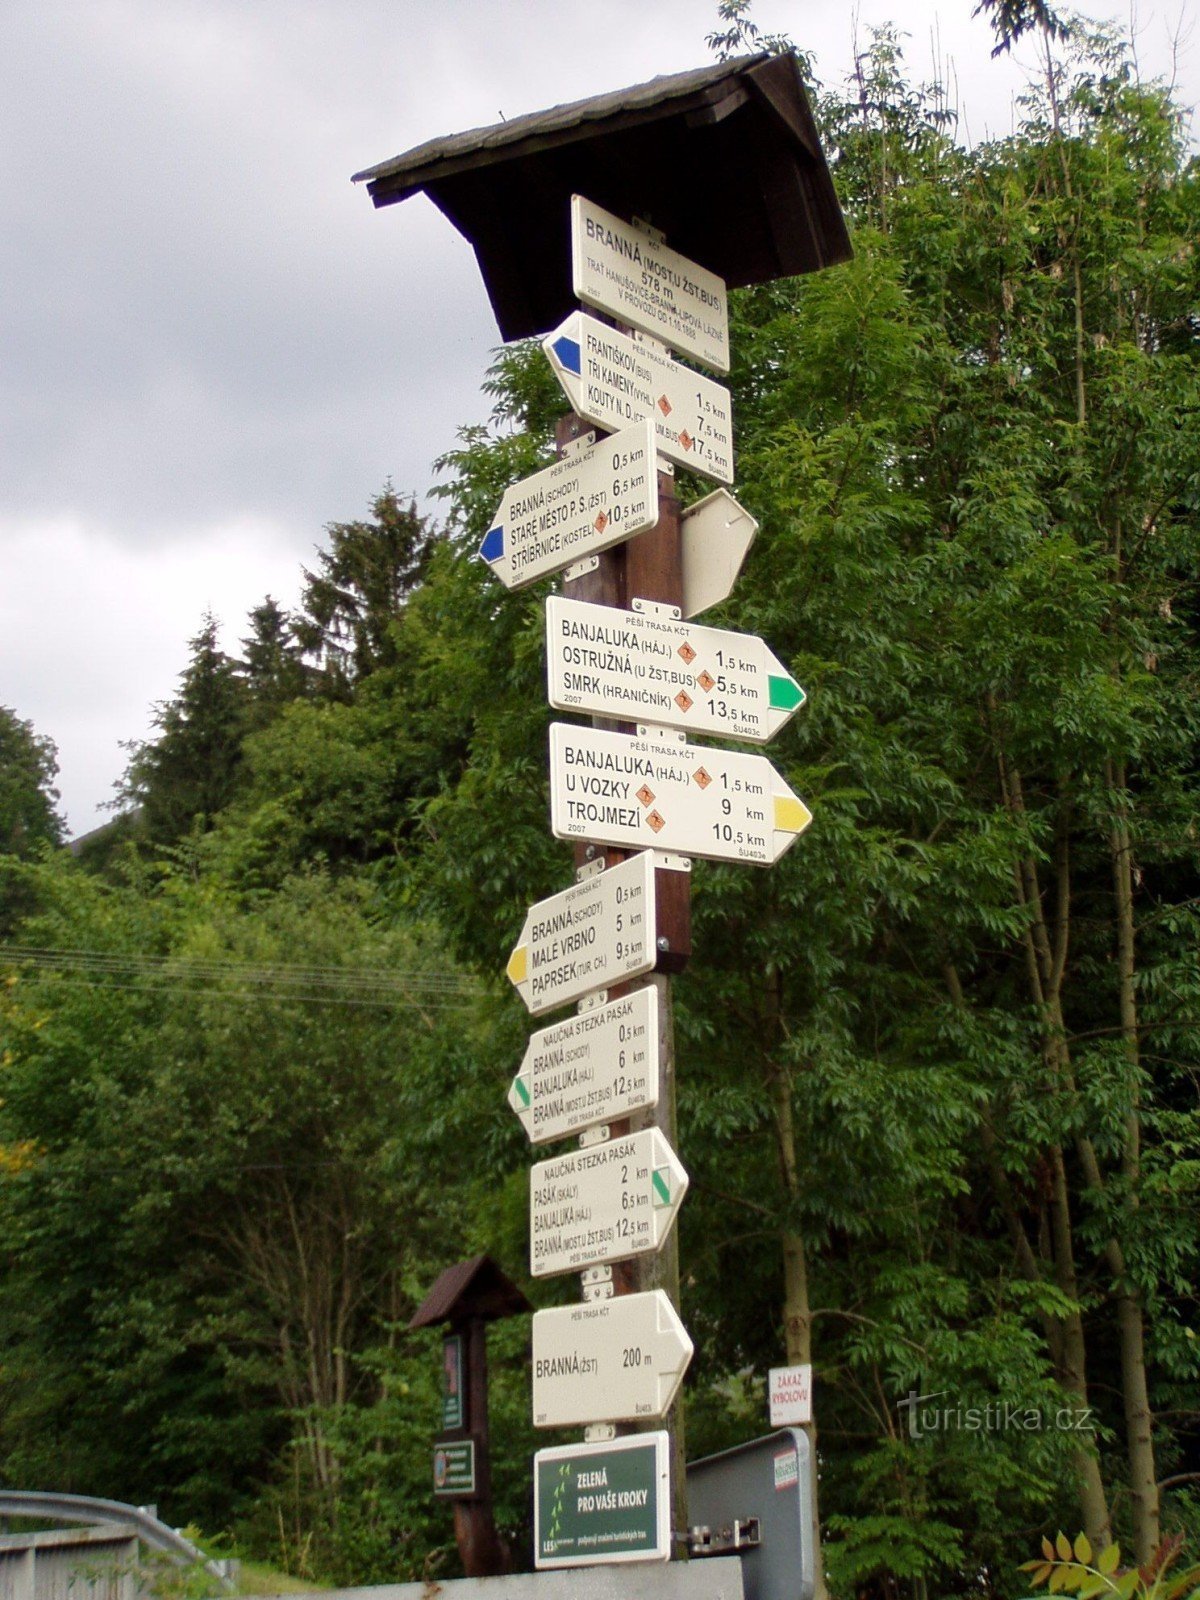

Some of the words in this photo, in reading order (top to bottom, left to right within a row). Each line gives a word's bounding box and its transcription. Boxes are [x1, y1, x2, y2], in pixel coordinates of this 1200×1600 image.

[587, 218, 642, 266] BRANNÁ
[619, 288, 623, 298] V
[625, 292, 656, 317] PROVOZU
[658, 310, 667, 322] OD
[642, 271, 659, 292] 578
[664, 287, 673, 300] m
[587, 334, 635, 372] FRANTIŠKOV
[637, 366, 651, 384] (BUS)
[697, 393, 710, 412] 1,5
[713, 405, 725, 420] km
[588, 358, 600, 380] TŘI
[602, 367, 634, 396] KAMENY
[697, 416, 711, 436] 7,5
[714, 429, 726, 443] km
[589, 406, 602, 416] 2007
[588, 384, 614, 411] KOUTY
[616, 398, 624, 416] N.
[626, 403, 633, 420] D.
[692, 437, 712, 460] 17,5
[715, 452, 727, 467] km
[564, 457, 582, 471] TRASA
[583, 451, 595, 463] KČT
[510, 487, 544, 521] BRANNÁ
[546, 479, 580, 506] (SCHODY)
[613, 454, 628, 471] 0,5
[630, 449, 644, 462] km
[510, 519, 537, 546] STARÉ
[540, 505, 568, 532] MĚSTO
[570, 501, 577, 517] P.
[579, 497, 587, 513] S.
[588, 491, 606, 512] (ŽST)
[613, 480, 628, 497] 6,5
[630, 475, 644, 489] km
[512, 533, 560, 570] STŘÍBRNICE
[561, 523, 595, 550] (KOSTEL)
[607, 506, 628, 525] 10,5
[630, 501, 645, 515] km
[512, 572, 523, 583] 2007
[562, 620, 639, 650] BANJALUKA
[642, 641, 672, 659] (HÁJ.)
[716, 651, 735, 670] 1,5
[739, 660, 756, 673] km
[626, 617, 643, 627] PĚŠÍ
[647, 621, 672, 633] TRASA
[674, 628, 689, 636] KČT
[563, 646, 632, 674] OSTRUŽNÁ
[635, 665, 645, 679] (U
[649, 665, 696, 689] ŽST,BUS)
[717, 676, 736, 695] 5,5
[741, 685, 758, 698] km
[564, 672, 600, 694] SMRK
[603, 685, 671, 710] (HRANIČNÍK)
[708, 699, 737, 720] 13,5
[741, 711, 759, 724] km
[564, 695, 582, 704] 2007
[565, 747, 654, 777] BANJALUKA
[656, 767, 689, 785] (HÁJ.)
[721, 773, 741, 792] 1,5
[745, 782, 763, 794] km
[631, 742, 648, 752] PĚŠÍ
[651, 746, 676, 756] TRASA
[680, 749, 695, 759] KČT
[566, 774, 575, 791] U
[581, 776, 629, 799] VOZKY
[722, 798, 731, 815] 9
[746, 807, 764, 820] km
[567, 801, 640, 828] TROJMEZÍ
[713, 823, 743, 844] 10,5
[747, 834, 765, 846] km
[568, 824, 586, 833] 2007
[532, 906, 572, 943] BRANNÁ
[573, 901, 603, 928] (SCHODY)
[616, 887, 628, 904] 0,5
[630, 886, 641, 897] km
[532, 939, 558, 969] MALÉ
[561, 926, 596, 954] VRBNO
[616, 914, 622, 932] 5
[630, 913, 642, 926] km
[532, 961, 577, 996] PAPRSEK
[616, 942, 629, 960] 9,5
[631, 941, 643, 954] km
[543, 1026, 574, 1048] NAUČNÁ
[576, 1014, 605, 1035] STEZKA
[607, 1001, 633, 1021] PASÁK
[534, 1043, 565, 1075] BRANNÁ
[619, 1025, 631, 1043] 0,5
[633, 1024, 645, 1038] km
[534, 1068, 577, 1100] BANJALUKA
[619, 1051, 625, 1069] 6
[633, 1051, 645, 1064] km
[534, 1096, 564, 1124] BRANNÁ
[613, 1076, 631, 1096] 12,5
[633, 1077, 645, 1091] km
[579, 1111, 594, 1122] TRASA
[544, 1158, 575, 1181] NAUČNÁ
[578, 1151, 607, 1172] STEZKA
[609, 1143, 636, 1163] PASÁK
[534, 1183, 557, 1209] PASÁK
[621, 1165, 628, 1184] 2
[637, 1168, 648, 1179] km
[534, 1206, 574, 1234] BANJALUKA
[622, 1191, 635, 1210] 6,5
[637, 1194, 648, 1206] km
[534, 1231, 562, 1259] BRANNÁ
[616, 1218, 635, 1238] 12,5
[637, 1220, 649, 1232] km
[582, 1250, 597, 1262] TRASA
[583, 1309, 598, 1320] TRASA
[536, 1351, 579, 1378] BRANNÁ
[580, 1358, 598, 1377] (ŽST)
[623, 1348, 641, 1367] 200
[644, 1356, 652, 1366] m
[577, 1467, 608, 1489] ZELENÁ
[578, 1497, 594, 1513] PRO
[596, 1490, 616, 1510] VAŠE
[618, 1489, 648, 1507] KROKY
